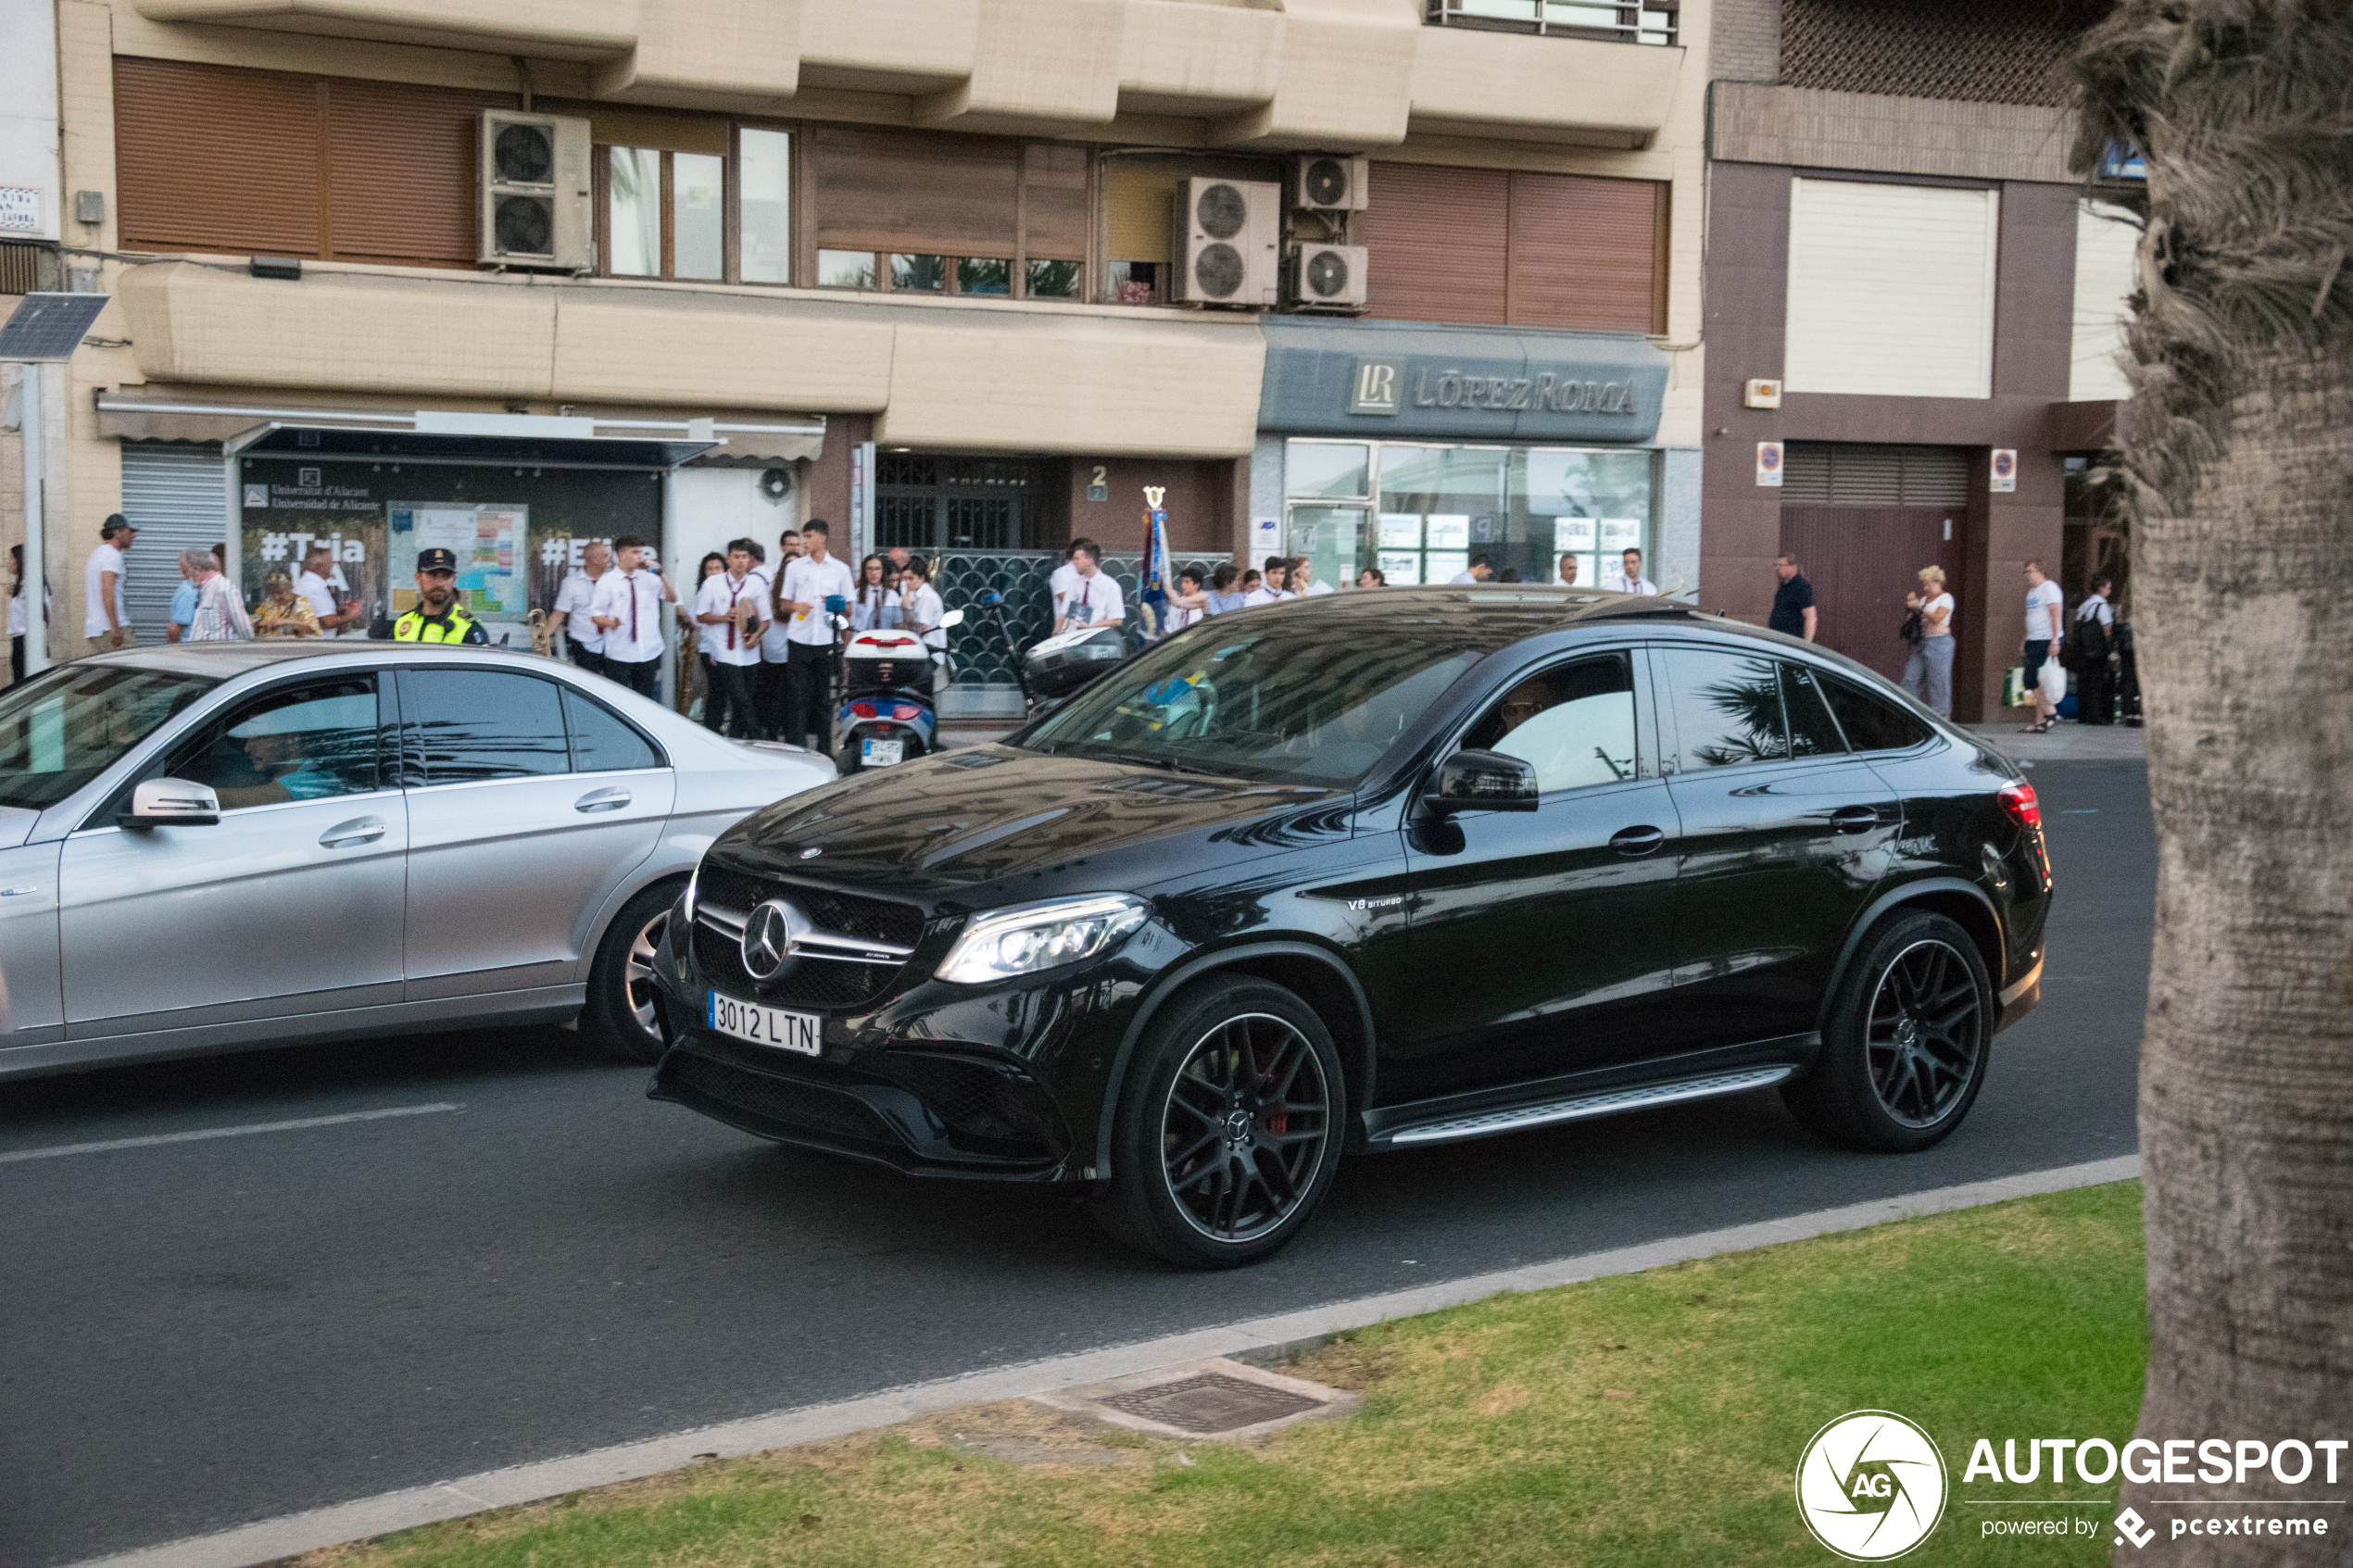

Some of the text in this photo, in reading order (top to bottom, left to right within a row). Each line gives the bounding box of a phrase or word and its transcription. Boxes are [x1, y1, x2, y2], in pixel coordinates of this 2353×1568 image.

[1359, 364, 1394, 402] LR
[1092, 465, 1106, 486] 2
[271, 497, 381, 510] Universidad de Alicante
[1348, 897, 1402, 911] V8 BITURBO
[718, 997, 813, 1049] 3012 LTN
